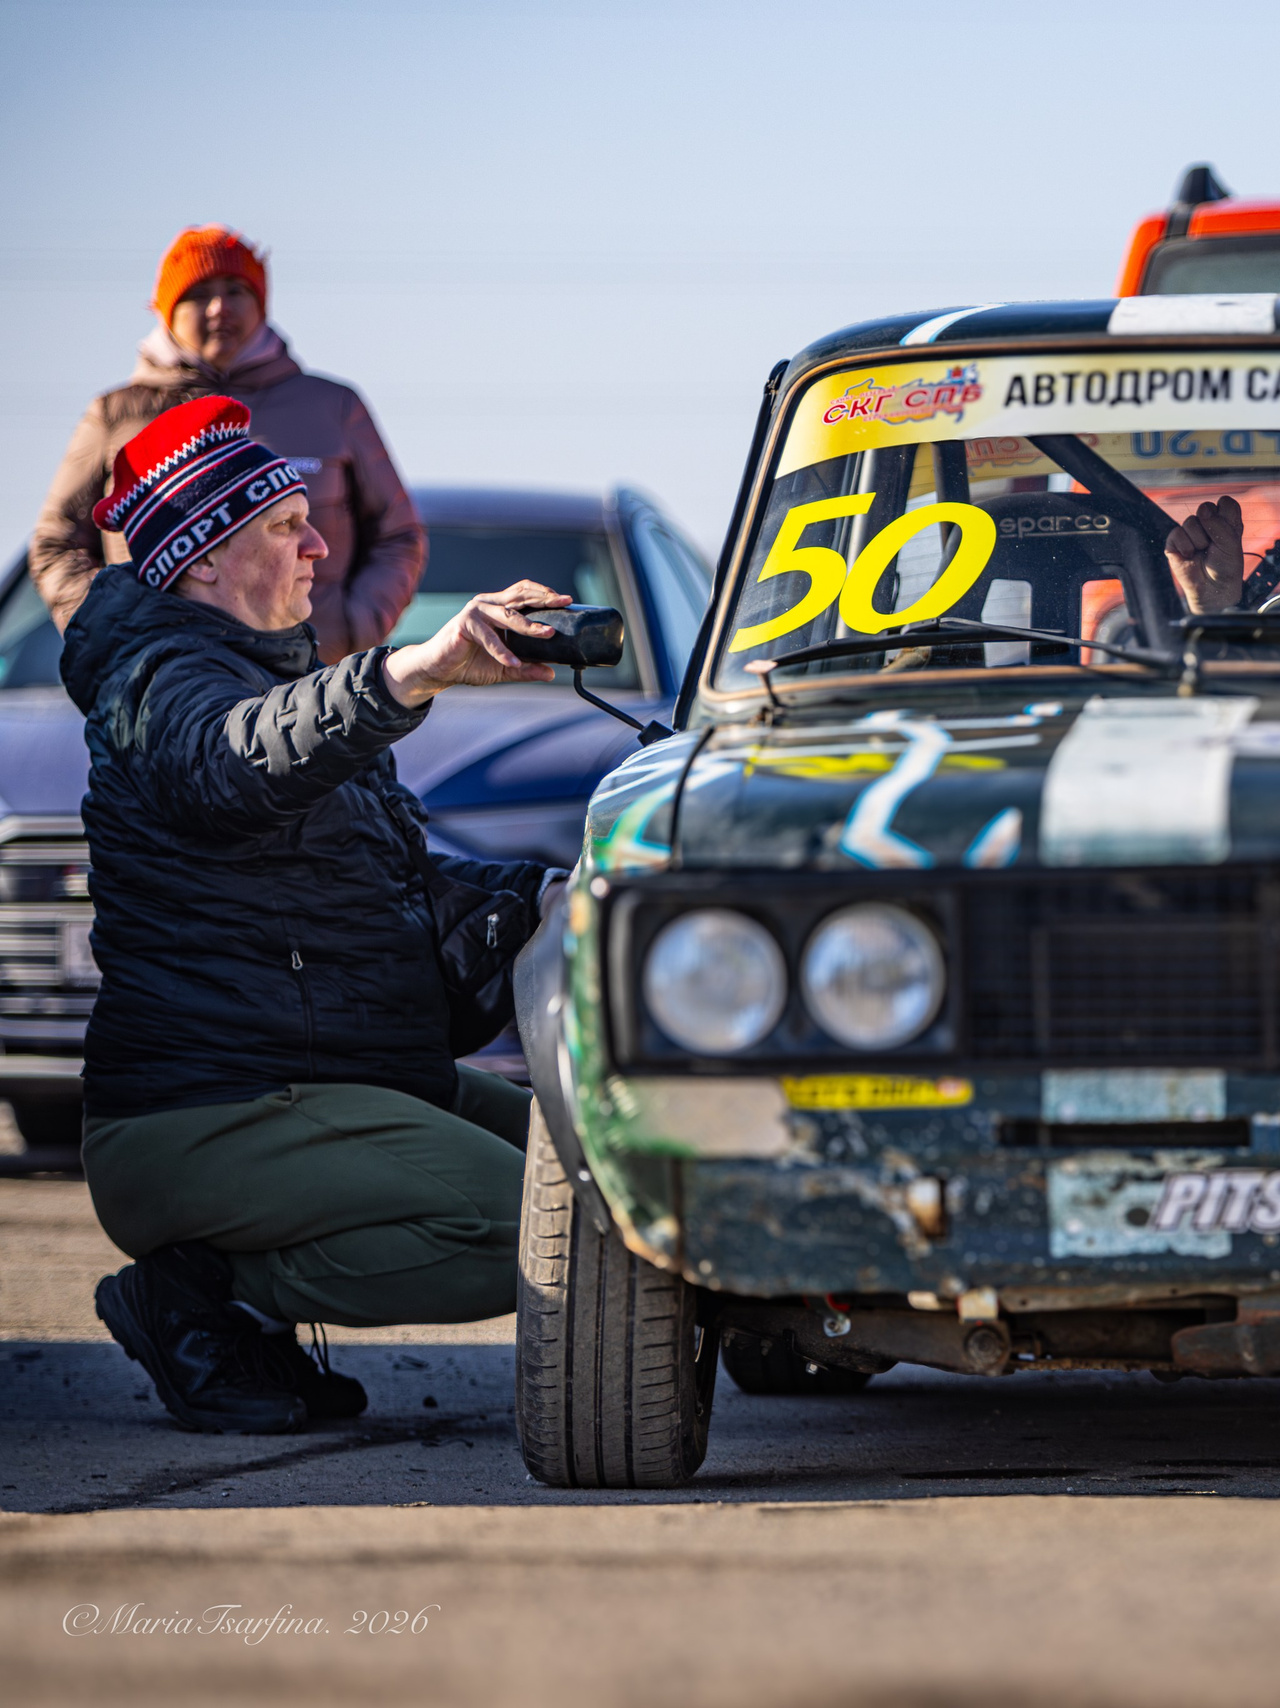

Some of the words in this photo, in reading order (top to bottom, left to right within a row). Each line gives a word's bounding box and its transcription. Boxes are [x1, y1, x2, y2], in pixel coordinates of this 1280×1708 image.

[822, 391, 895, 424] СКГ
[904, 383, 983, 409] СПБ
[1005, 369, 1231, 407] АВТОДРОМ
[146, 503, 230, 587] СПОРТ
[999, 514, 1111, 539] sparco
[728, 492, 997, 653] 50
